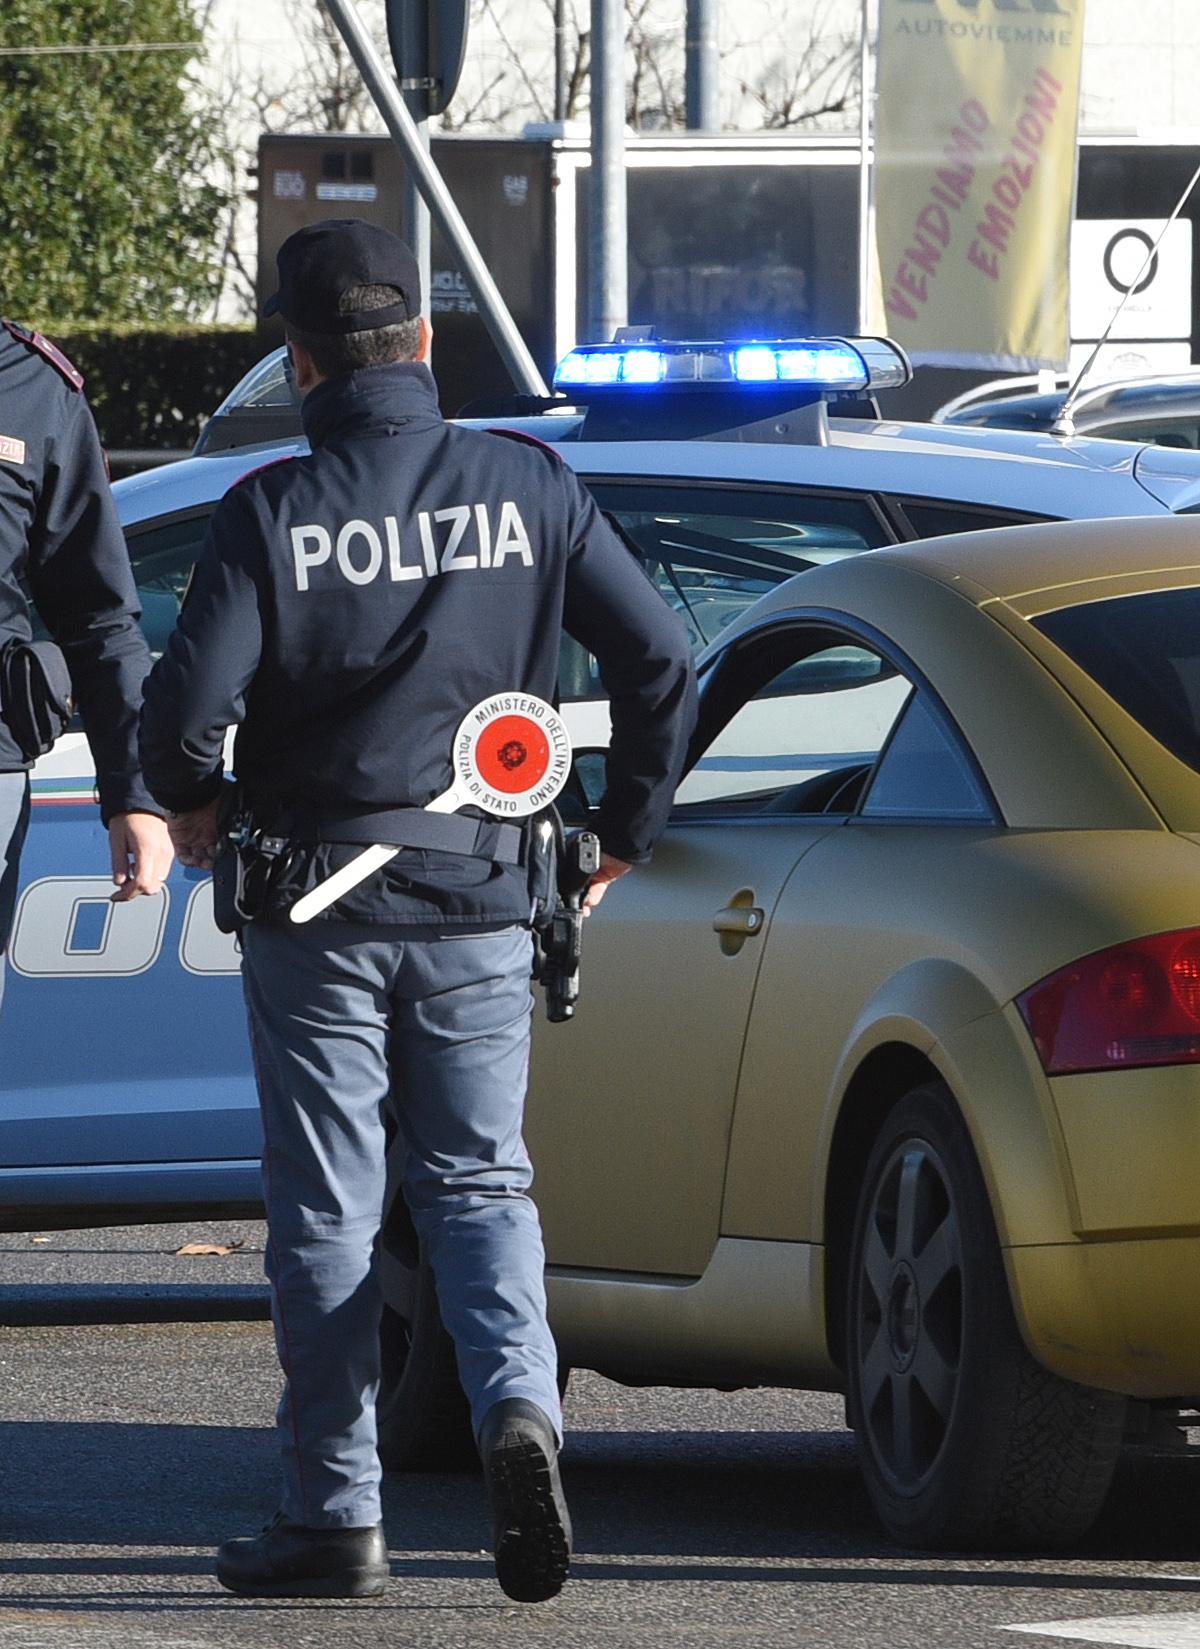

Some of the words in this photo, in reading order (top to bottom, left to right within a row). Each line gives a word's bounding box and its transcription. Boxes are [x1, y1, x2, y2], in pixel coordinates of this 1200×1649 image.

[896, 18, 1073, 46] AUTOVIEMME
[887, 97, 990, 320] VENDIAMO
[967, 66, 1063, 280] EMOZIONI
[290, 501, 535, 592] POLIZIA
[459, 734, 473, 781] POLIZIA
[469, 782, 482, 796] DI
[482, 793, 517, 812] STATO
[475, 698, 545, 725] MINISTERO
[529, 717, 567, 806] DELL'INTERNO
